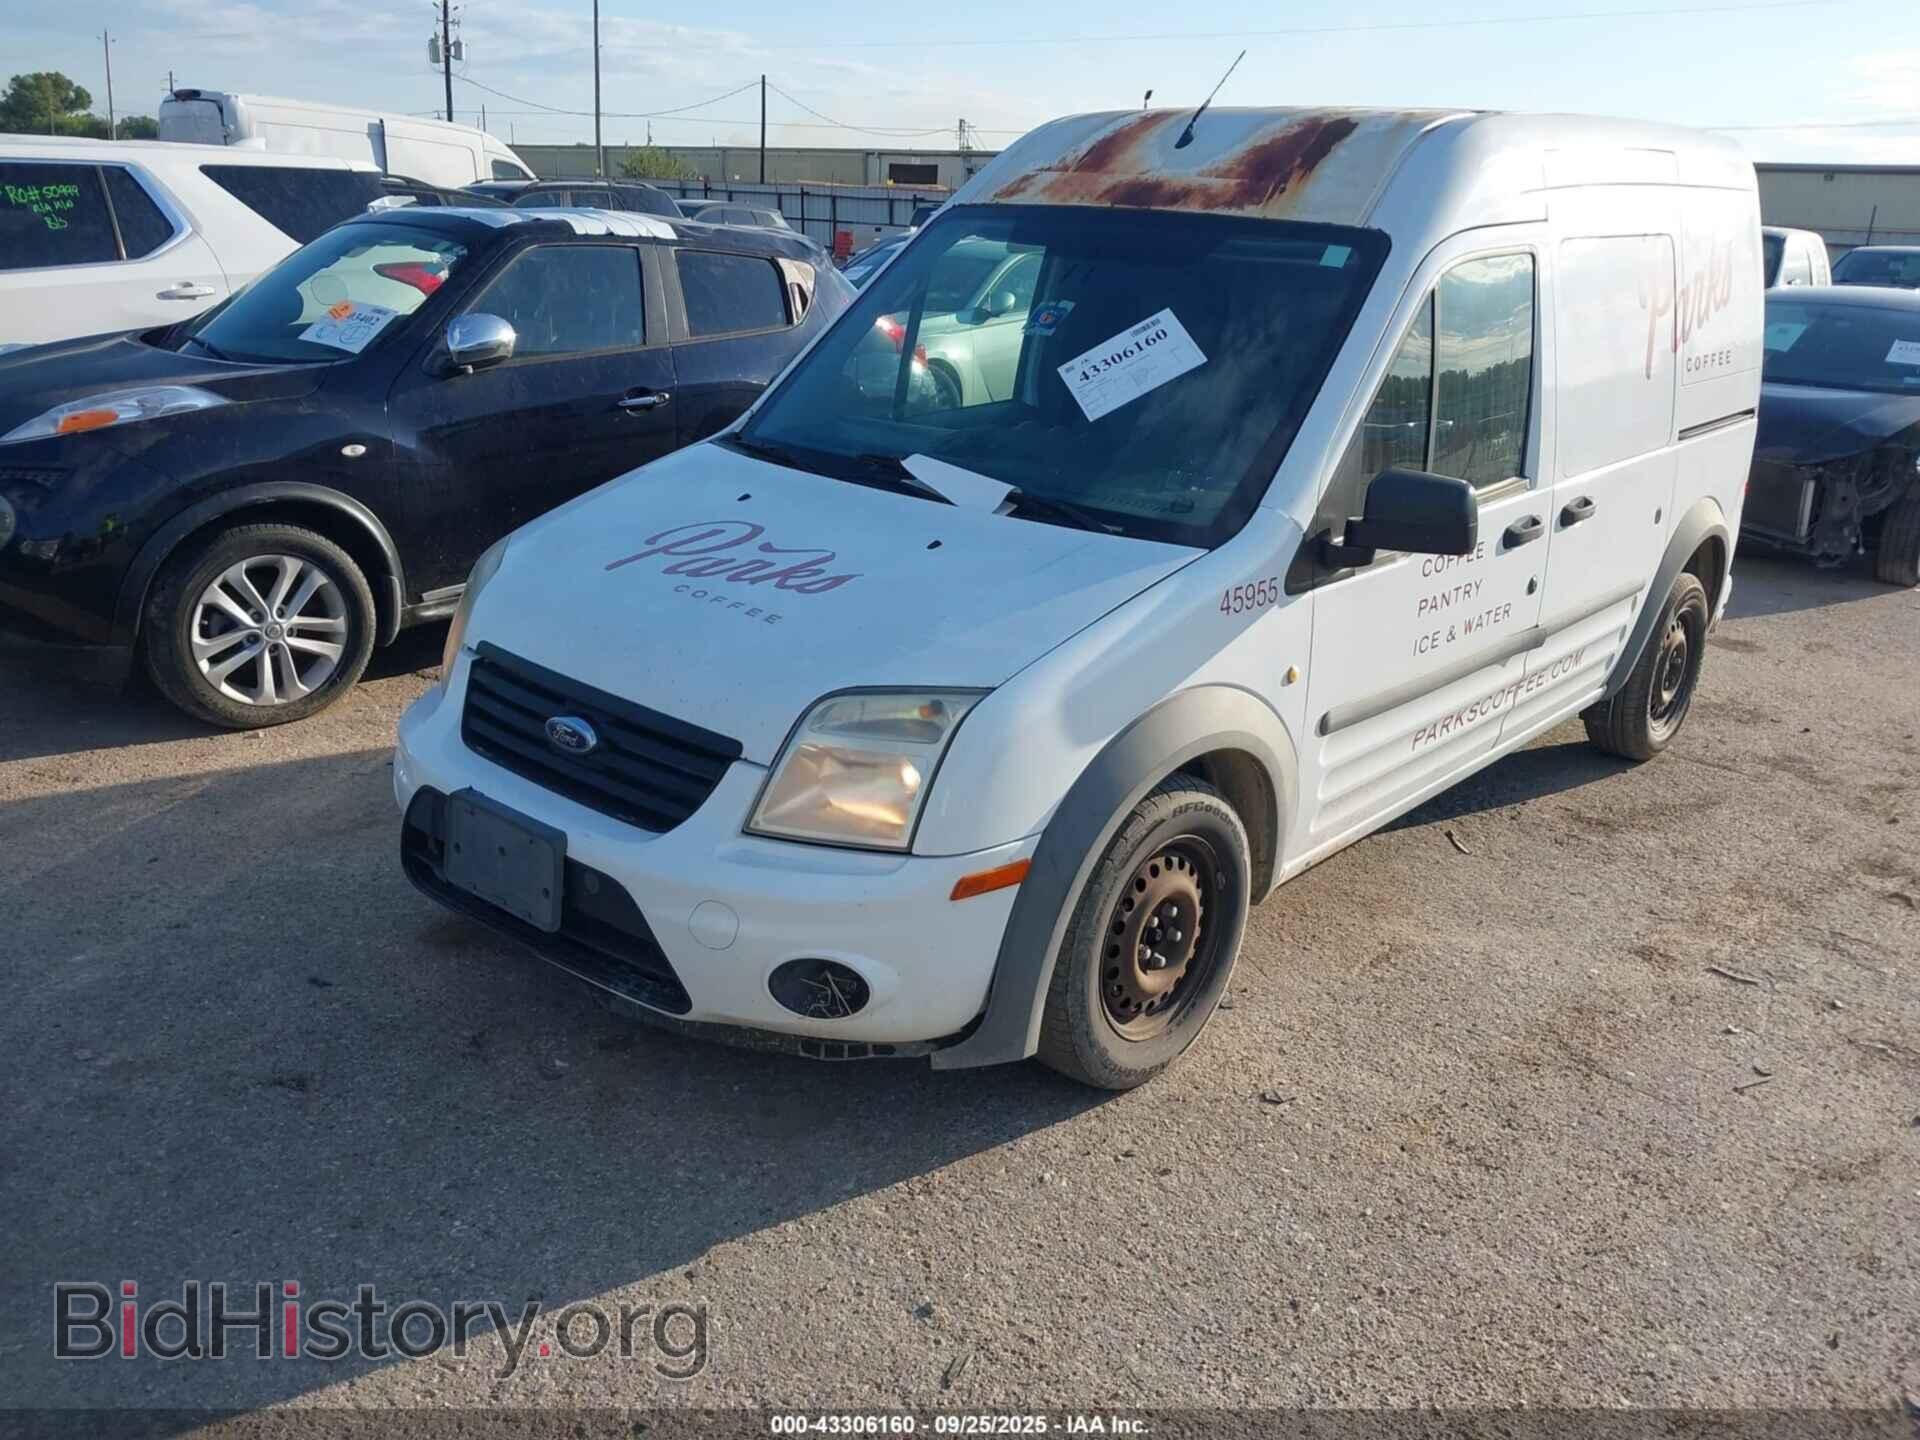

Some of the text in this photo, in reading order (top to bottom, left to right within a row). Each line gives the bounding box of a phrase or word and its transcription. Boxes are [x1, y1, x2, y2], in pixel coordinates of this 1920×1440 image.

[1079, 328, 1168, 382] 43306160
[1685, 349, 1732, 373] COFFEE
[604, 520, 865, 595] Parks
[673, 583, 784, 625] COFFEE
[1219, 576, 1279, 616] 45955
[1416, 578, 1484, 619] PANTRY
[1412, 602, 1512, 657] ICE & WATER
[1411, 649, 1586, 751] PARKSCOFFEE.COM
